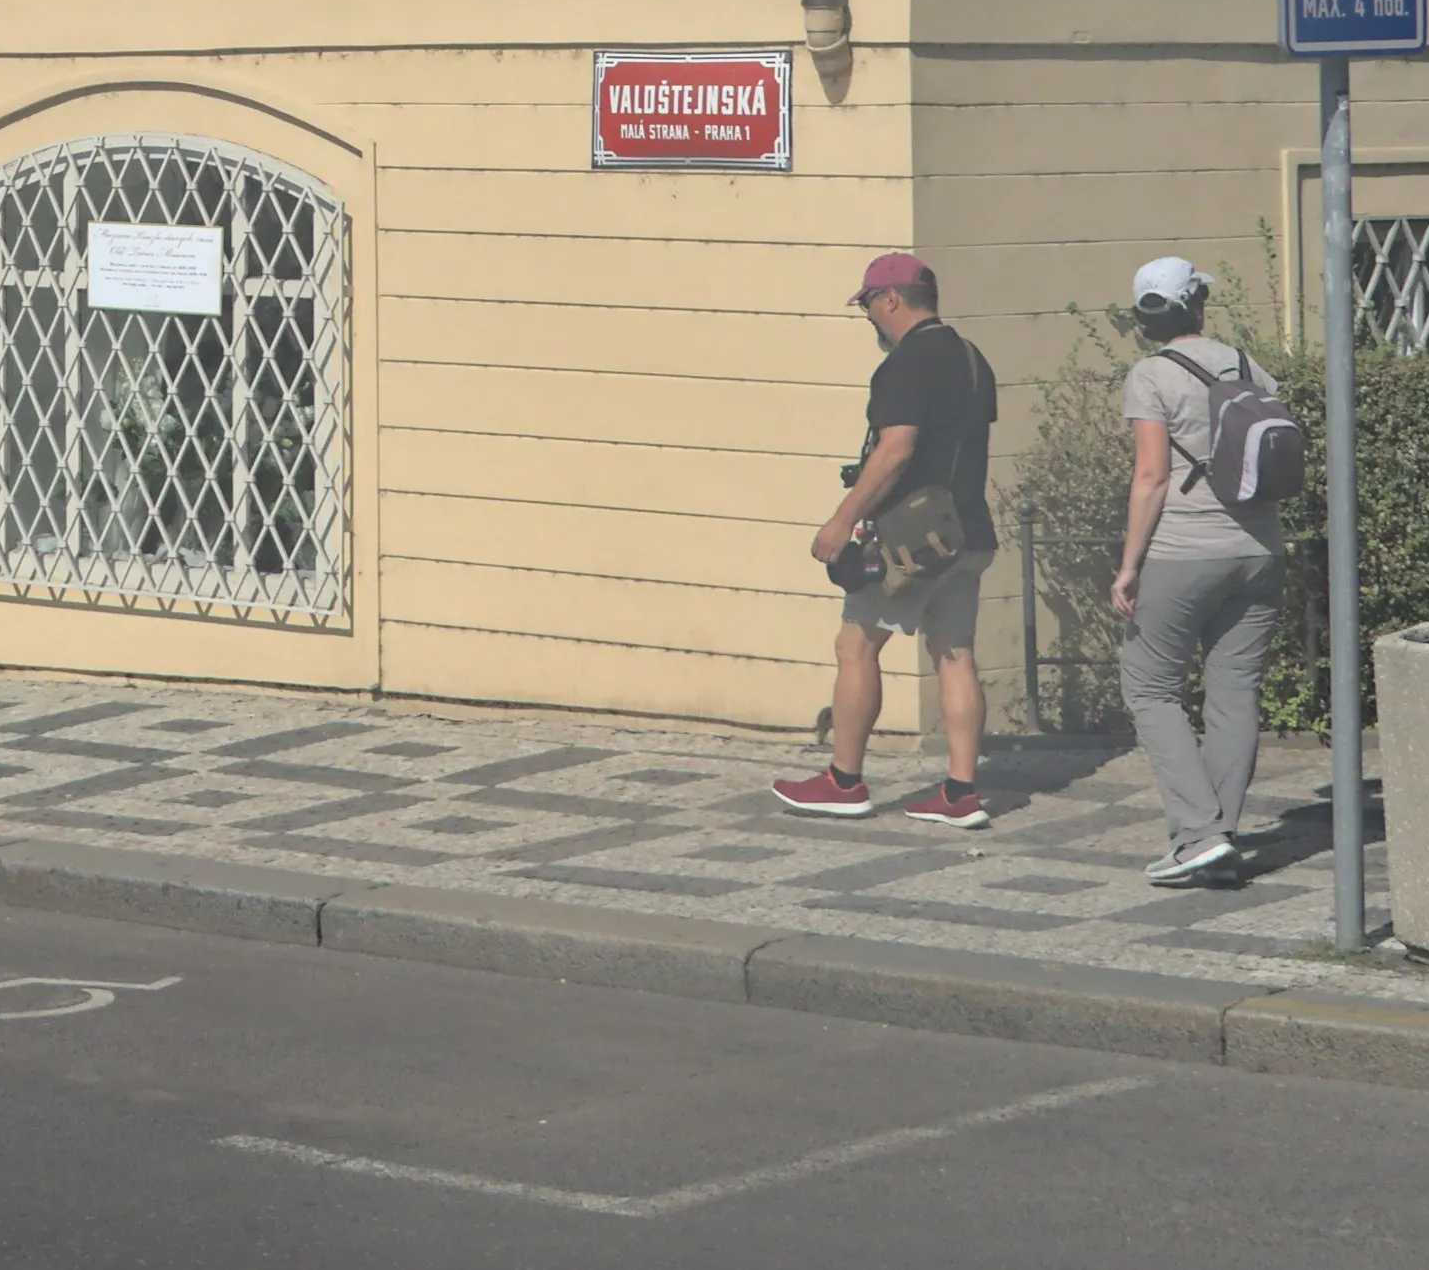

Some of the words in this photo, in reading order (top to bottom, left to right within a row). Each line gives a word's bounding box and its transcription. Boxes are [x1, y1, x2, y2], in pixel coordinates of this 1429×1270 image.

[609, 79, 767, 116] VALDŠTEJNSKÁ
[620, 119, 645, 140] MALÁ
[649, 124, 690, 140] STRANA
[704, 124, 742, 141] PRAHA
[745, 125, 751, 141] 1
